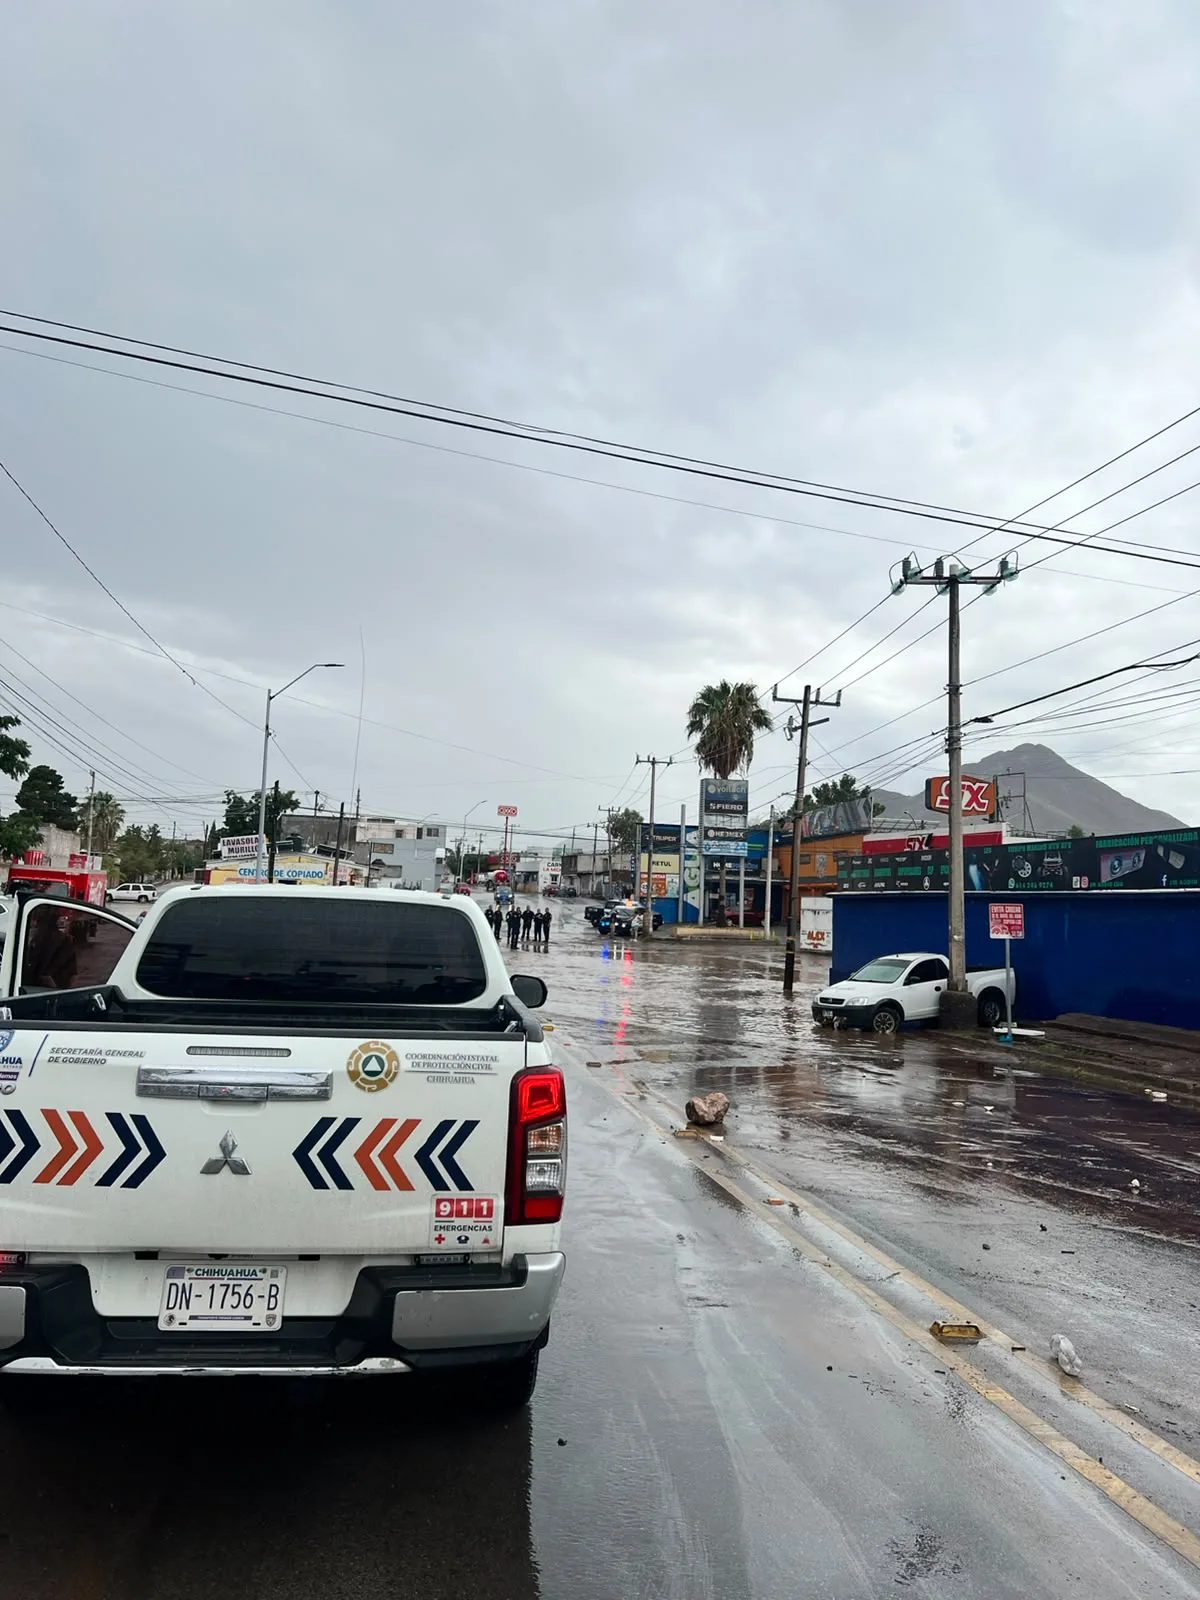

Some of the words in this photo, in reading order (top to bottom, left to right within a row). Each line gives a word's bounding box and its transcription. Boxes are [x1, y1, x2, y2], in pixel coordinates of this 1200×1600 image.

[499, 806, 517, 815] OXXO
[716, 803, 743, 811] FIERO
[274, 869, 284, 877] DE
[287, 869, 323, 878] COPIADO
[807, 930, 825, 941] ALEX
[50, 1047, 103, 1056] SECRETARÍA
[105, 1049, 145, 1058] GENERAL
[62, 1057, 107, 1065] GOBIERNO
[405, 1053, 466, 1061] COORDINACIÓN
[466, 1054, 499, 1063] ESTATAL
[423, 1061, 471, 1070] PROTECCIÓN
[426, 1075, 476, 1084] CHIHUAHUA
[439, 1201, 488, 1216] 911
[434, 1224, 493, 1232] EMERGENCIAS
[195, 1268, 258, 1277] CHIHUAHUA
[166, 1282, 280, 1311] DN-1756-B
